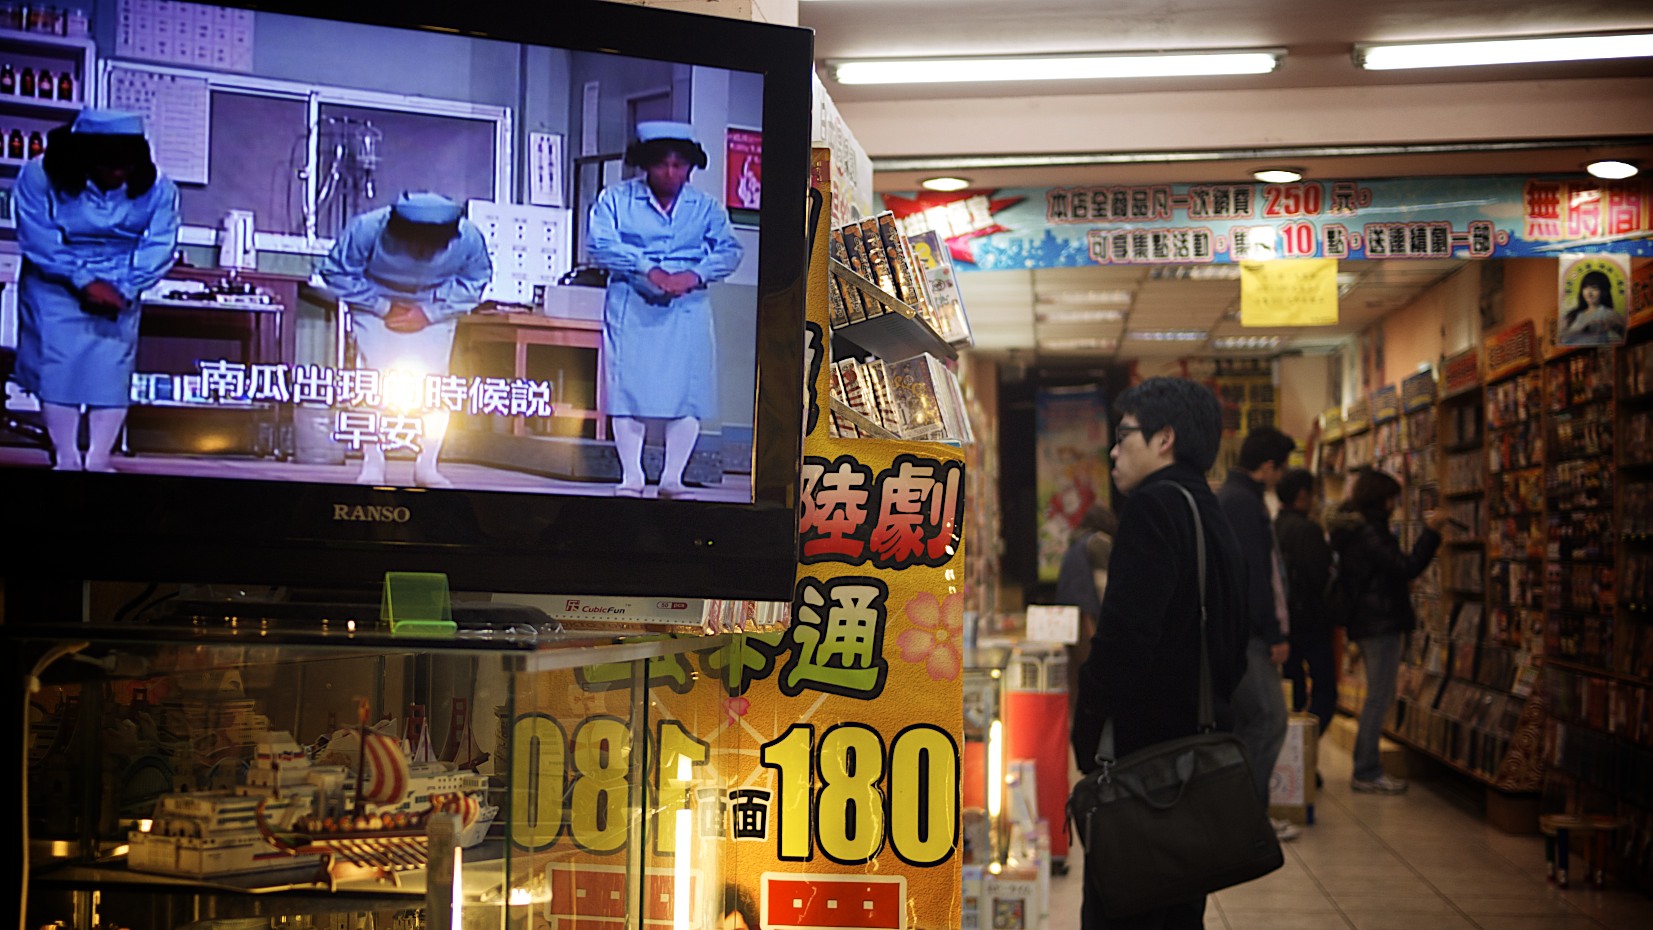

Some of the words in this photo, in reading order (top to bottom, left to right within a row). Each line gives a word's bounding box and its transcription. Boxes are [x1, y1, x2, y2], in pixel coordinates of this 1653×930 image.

[1264, 182, 1322, 217] 250
[1527, 182, 1653, 238] 無時間
[1282, 221, 1313, 256] 10
[333, 410, 424, 452] 早安
[333, 503, 411, 524] RANSO
[581, 605, 626, 615] CubicFun
[729, 788, 772, 839] 面
[761, 723, 960, 866] 180
